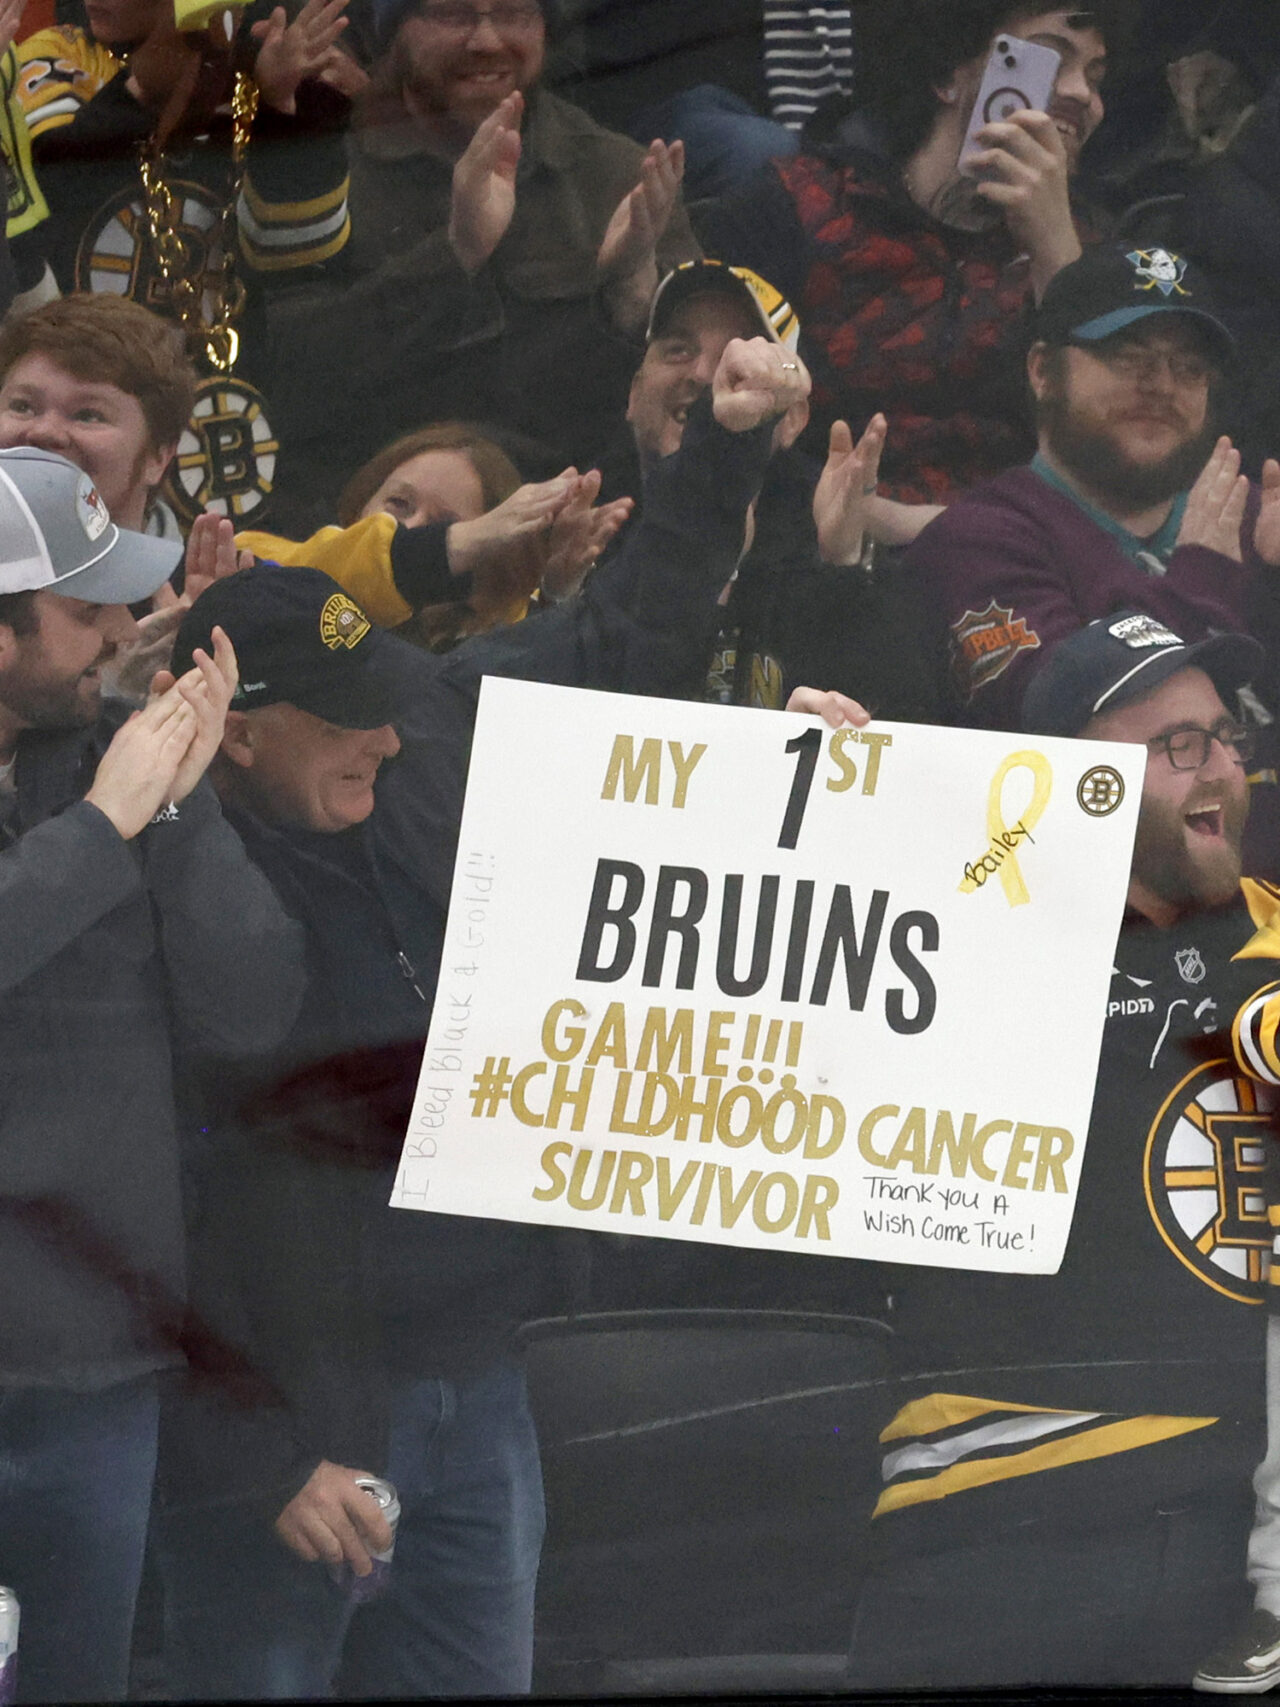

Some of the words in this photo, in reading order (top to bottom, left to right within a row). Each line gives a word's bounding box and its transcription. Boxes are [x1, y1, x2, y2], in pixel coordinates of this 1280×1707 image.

[198, 411, 256, 496] B
[600, 733, 709, 810] MY
[964, 820, 1036, 888] Bailey
[576, 857, 941, 1036] BRUINS
[429, 993, 473, 1071] Black
[541, 998, 804, 1089] GAME!!!
[405, 1086, 454, 1158] Bleed
[858, 1104, 1075, 1194] CANCER
[401, 1169, 430, 1201] I
[532, 1141, 840, 1241] SURVIVOR
[863, 1177, 935, 1203] Thank
[938, 1188, 979, 1211] you
[993, 1194, 1010, 1216] A
[864, 1210, 915, 1237] Wish
[921, 1216, 970, 1245] Come
